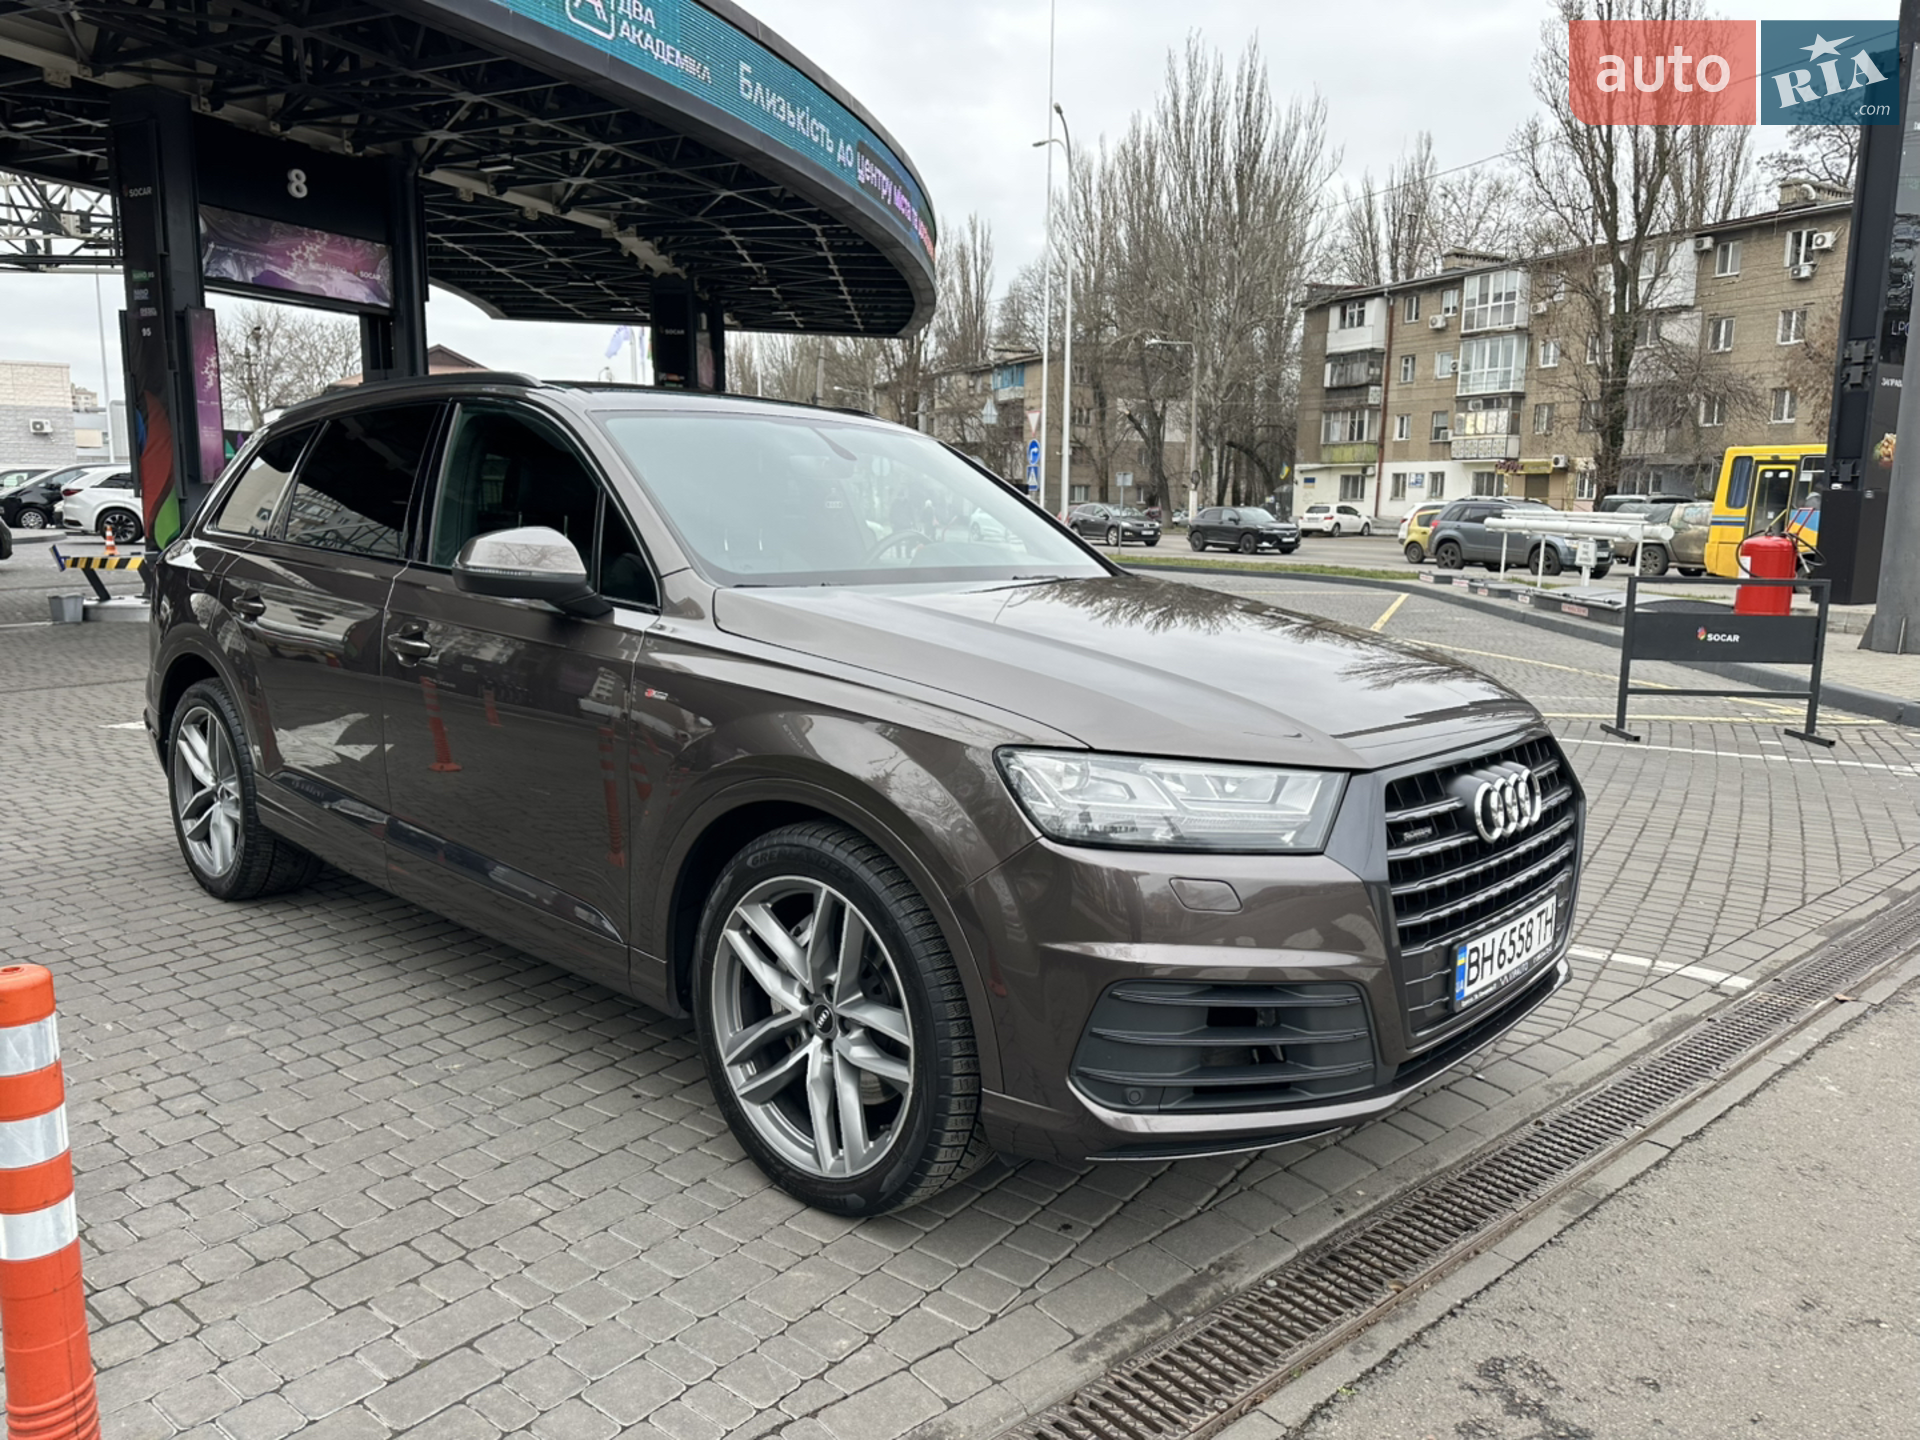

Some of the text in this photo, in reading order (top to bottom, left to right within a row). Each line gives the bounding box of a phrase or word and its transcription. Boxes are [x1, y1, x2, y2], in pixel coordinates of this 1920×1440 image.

[618, 0, 656, 29] ДВА
[738, 60, 835, 154] Близькість
[836, 138, 855, 168] до
[856, 151, 894, 205] центру
[287, 168, 308, 199] 8
[128, 186, 152, 198] SOCAR
[360, 270, 382, 281] SOCAR
[141, 327, 152, 337] 95
[1707, 633, 1740, 643] SOCAR
